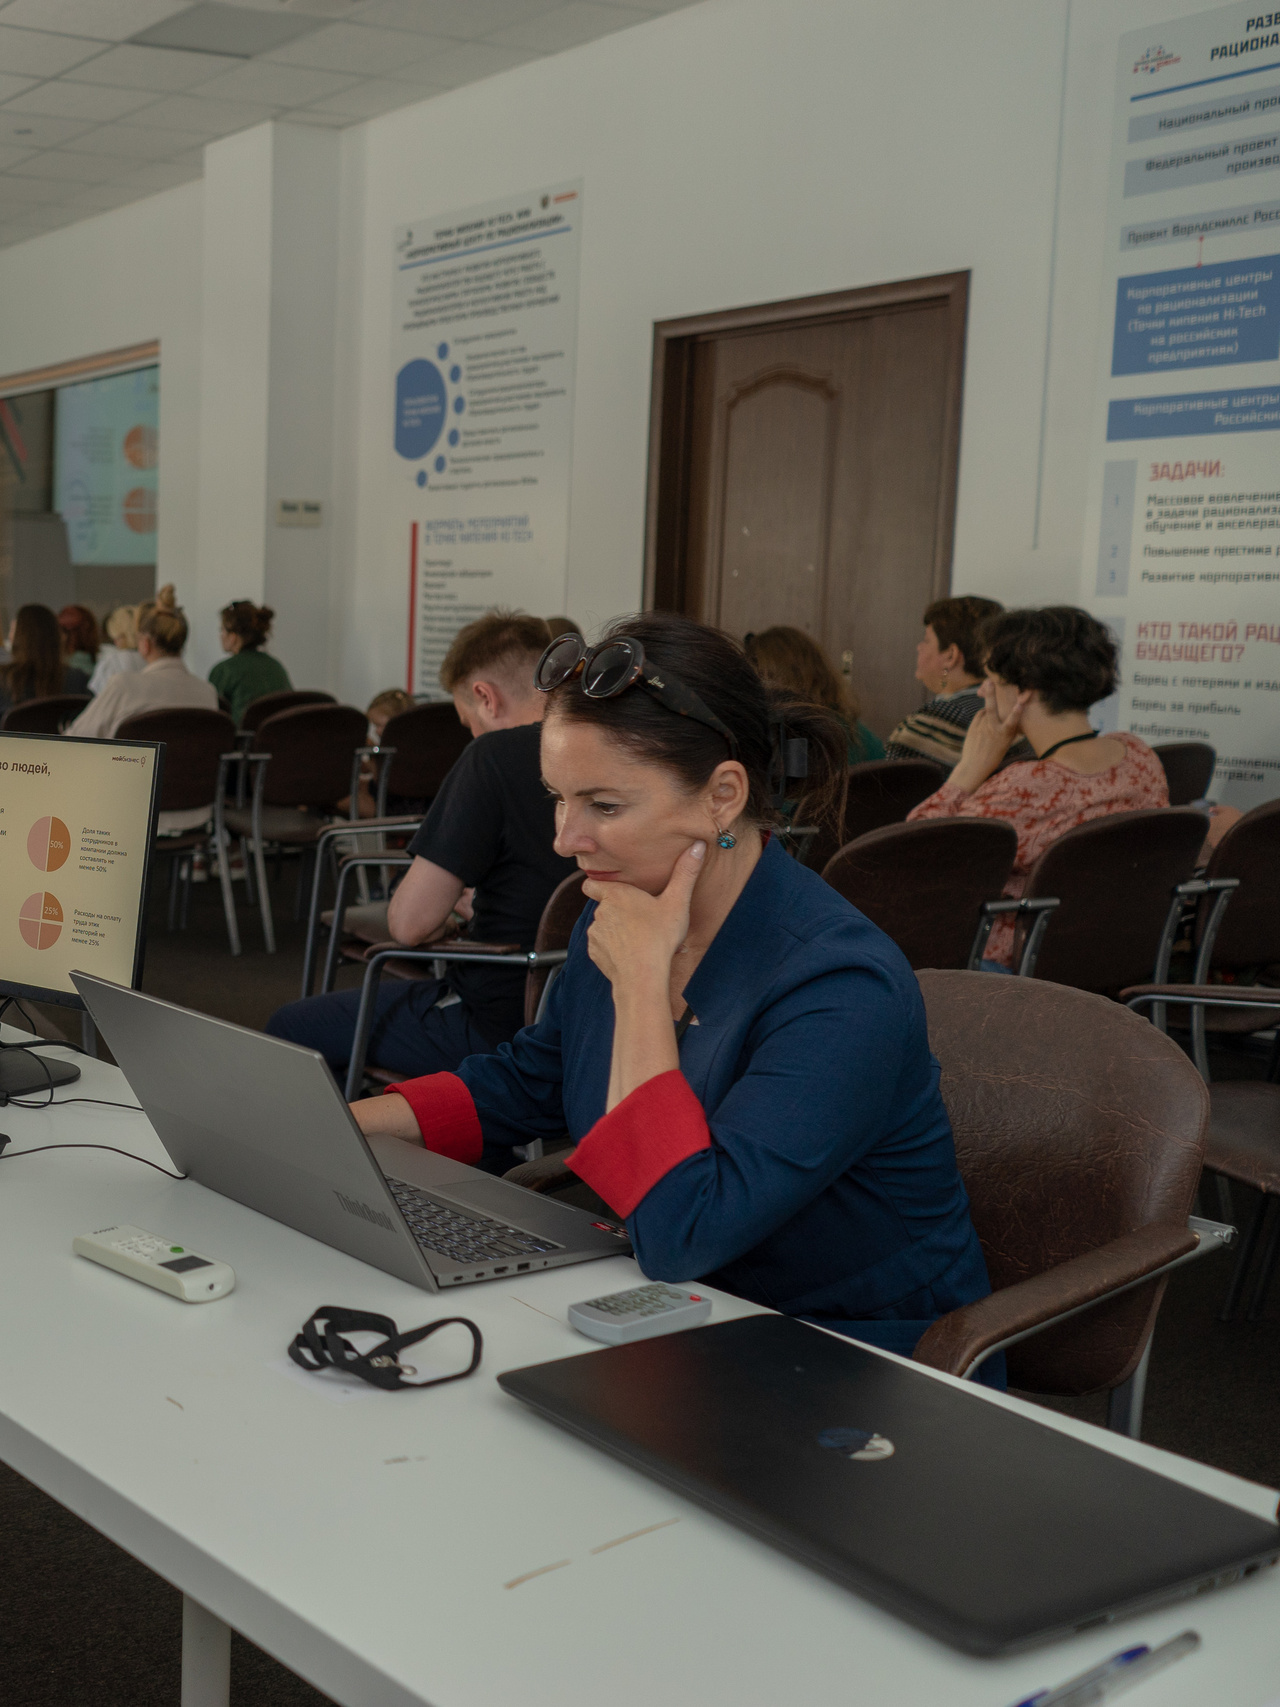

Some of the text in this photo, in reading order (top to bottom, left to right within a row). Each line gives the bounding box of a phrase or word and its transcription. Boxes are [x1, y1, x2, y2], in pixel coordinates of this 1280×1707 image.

[1246, 11, 1280, 32] РАЗВ
[1210, 32, 1280, 61] РАЦИОНА
[1159, 101, 1250, 130] Национальный
[1146, 137, 1277, 171] Федеральный проект
[1128, 227, 1168, 244] Проект
[1172, 216, 1249, 237] Ворлдскиллс
[1127, 271, 1272, 300] Корпоративные центры
[1137, 290, 1258, 315] по рационализации
[1128, 304, 1266, 333] (Точки кипения Hi-Tech
[1151, 327, 1238, 346] на российских
[1148, 340, 1239, 363] предприятиях)
[1134, 393, 1279, 416] Корпоративные центры
[1150, 459, 1225, 482] ЗАДАЧИ:
[1147, 494, 1204, 506] Массовое
[1147, 510, 1152, 518] в
[1157, 508, 1198, 519] задачи
[1146, 520, 1201, 534] обучение
[1206, 521, 1212, 530] и
[1144, 545, 1210, 557] Повышение
[1214, 545, 1272, 558] престижа
[1142, 571, 1195, 582] Развитие
[1137, 619, 1280, 642] КТО ТАКОЙ РАЦ
[1136, 642, 1245, 663] БУДУЩЕГО?
[1134, 672, 1168, 687] Борец
[1172, 676, 1177, 686] с
[1182, 676, 1240, 690] потерями
[1244, 679, 1251, 689] и
[1132, 697, 1241, 716] Борец за прибыль
[1130, 722, 1210, 739] Изобретатель
[11, 762, 51, 776] людей,
[50, 840, 63, 849] 50%
[81, 837, 114, 846] сотрудников
[80, 856, 107, 864] составлять
[44, 907, 59, 916] 25%
[74, 909, 95, 918] Расходы
[104, 914, 121, 923] оплату
[73, 919, 87, 927] труда
[71, 937, 88, 945] менее
[72, 927, 98, 938] категорий
[332, 1189, 398, 1234] ThinkBook
